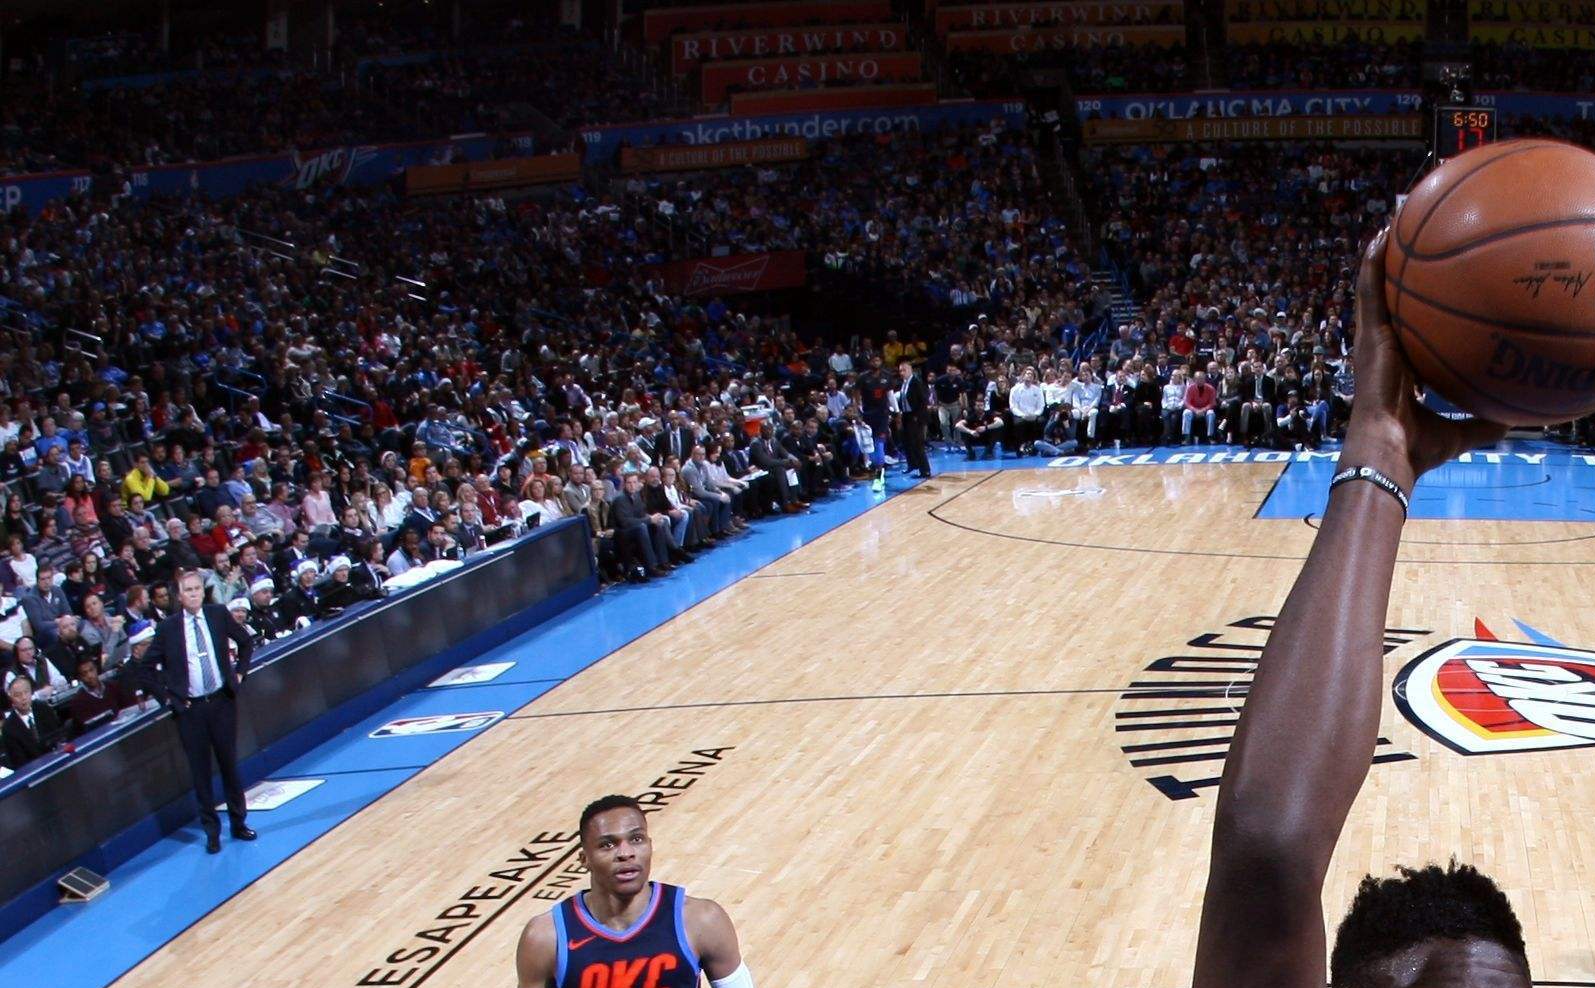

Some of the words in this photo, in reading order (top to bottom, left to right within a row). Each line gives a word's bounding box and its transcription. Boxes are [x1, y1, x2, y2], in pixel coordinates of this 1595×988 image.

[971, 6, 1152, 26] RIVERWIND
[681, 30, 897, 61] RIVERWIND
[1009, 32, 1125, 51] CASINO
[748, 59, 880, 87] CASINO
[1002, 103, 1024, 114] 119
[1077, 100, 1102, 113] 120
[1124, 99, 1293, 120] OKLAHOMA
[1304, 97, 1373, 116] CITY
[1203, 121, 1270, 138] CULTURE
[1279, 120, 1297, 136] OF
[1305, 120, 1336, 136] THE
[1343, 118, 1421, 136] POSSIBLE
[1453, 111, 1489, 128] 6:50
[681, 114, 920, 146] okcthundercom
[1047, 450, 1342, 468] OKLAHOM
[533, 863, 592, 901] ENE
